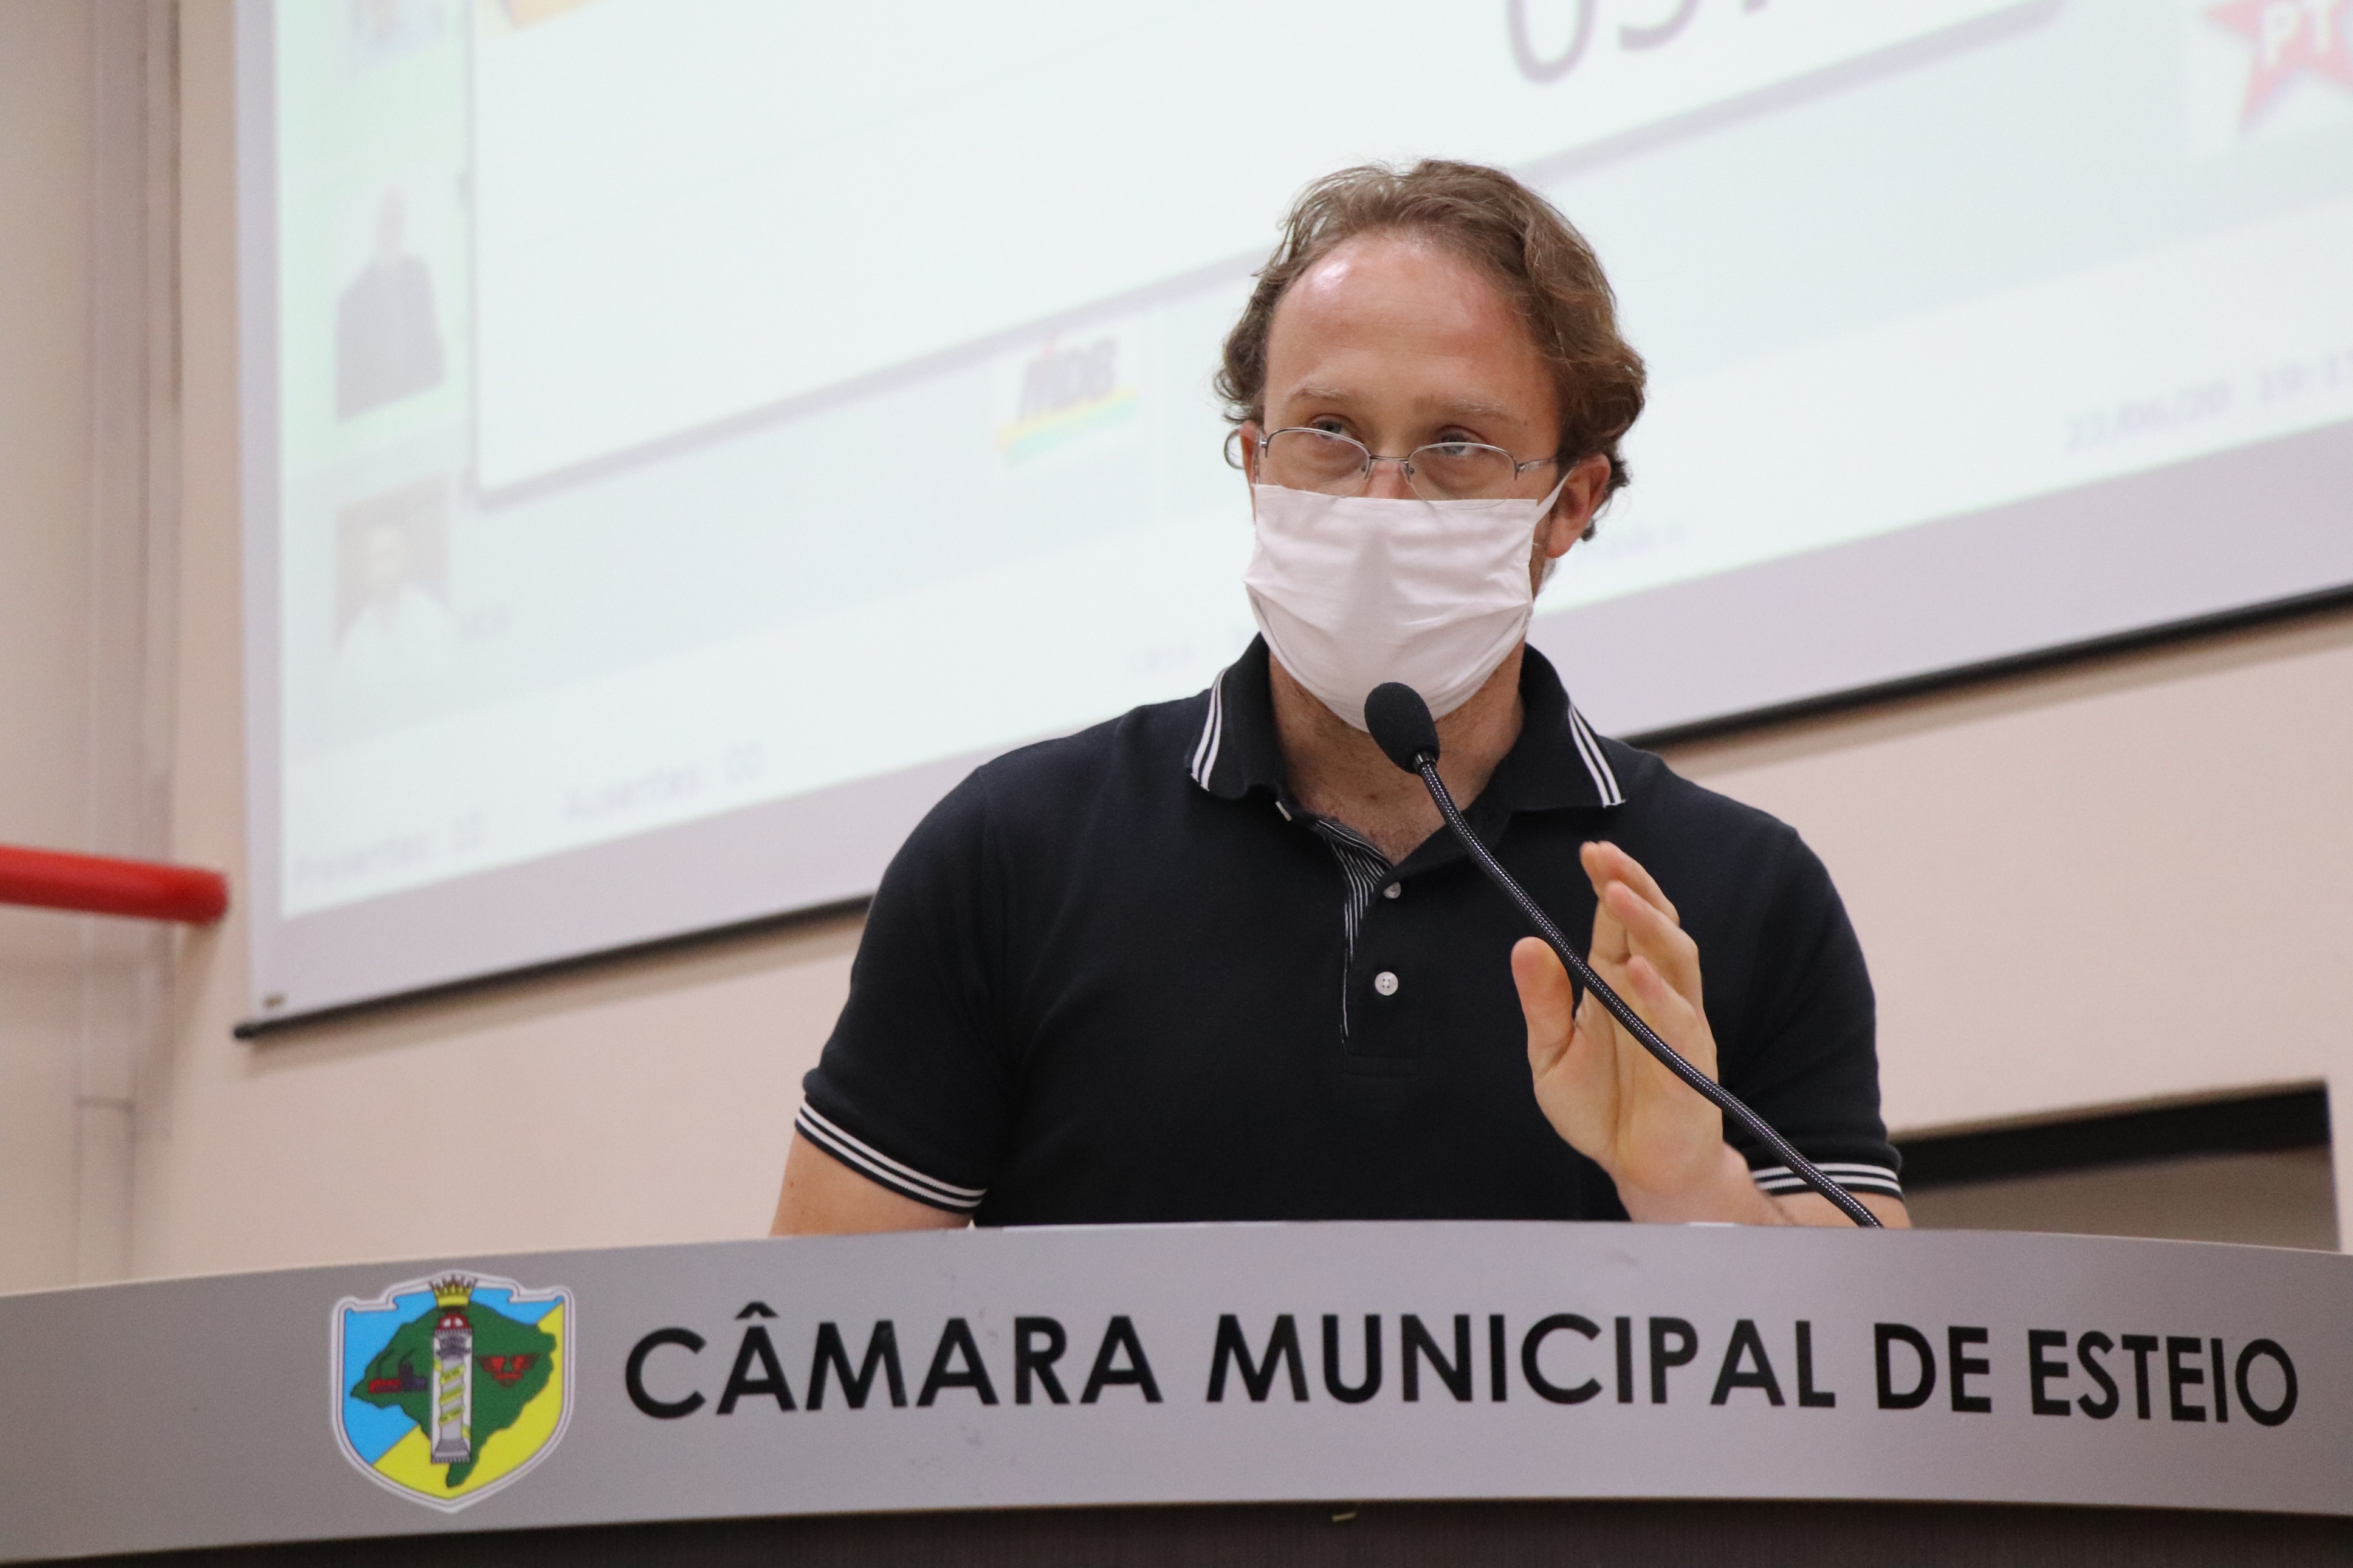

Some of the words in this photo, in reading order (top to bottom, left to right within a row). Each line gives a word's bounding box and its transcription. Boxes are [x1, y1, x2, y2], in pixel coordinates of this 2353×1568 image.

[625, 1301, 1164, 1420] CÂMARA
[1206, 1312, 1836, 1408] MUNICIPAL
[1874, 1321, 1992, 1414] DE
[2028, 1329, 2299, 1427] ESTEIO
